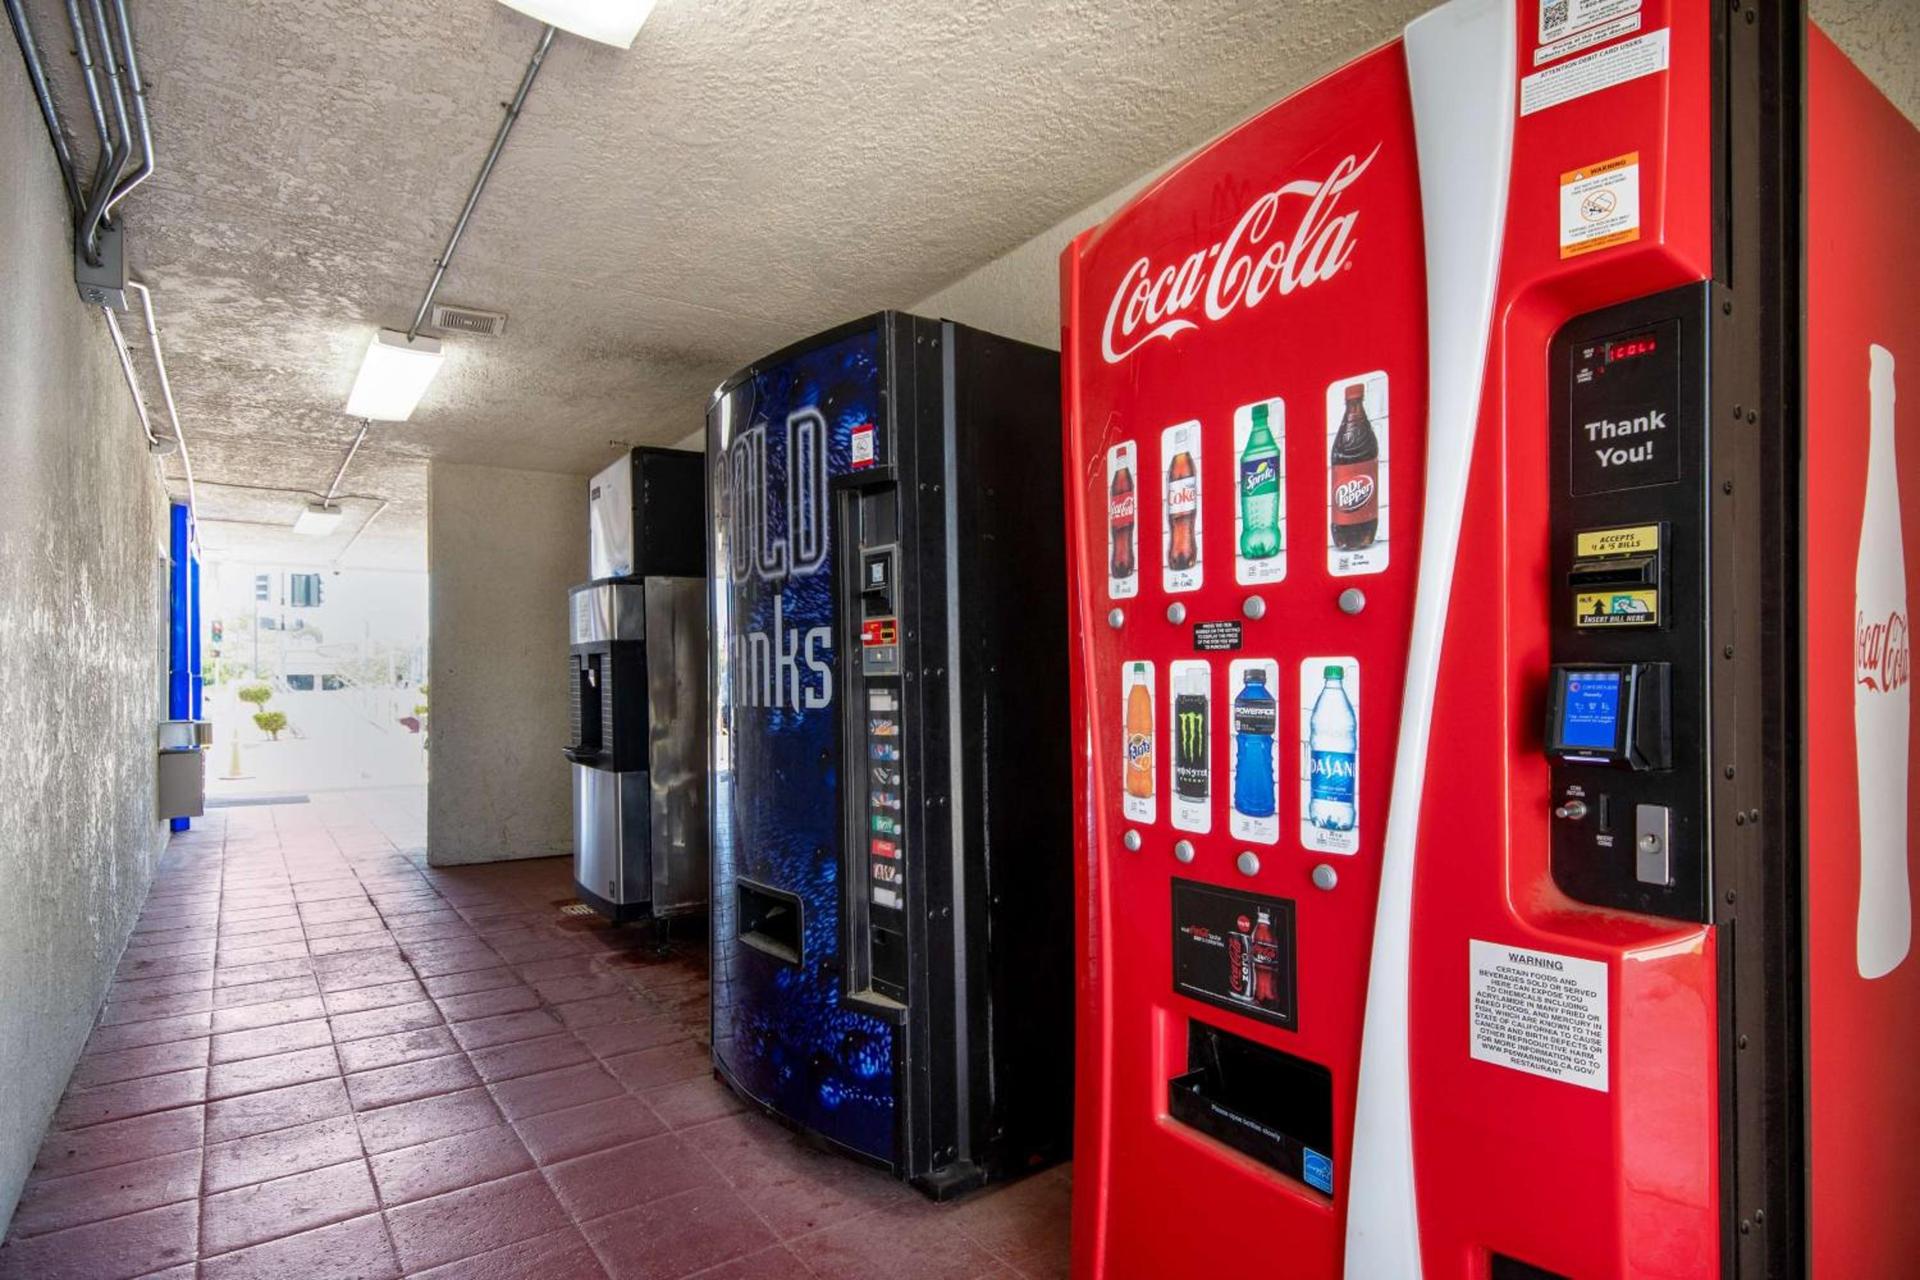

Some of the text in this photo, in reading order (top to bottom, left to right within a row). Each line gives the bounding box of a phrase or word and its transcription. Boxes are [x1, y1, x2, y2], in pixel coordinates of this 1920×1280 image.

[1540, 61, 1578, 78] ATTENTION
[1578, 53, 1599, 66] DEBIT
[1599, 46, 1619, 58] CARD
[1590, 159, 1627, 175] WARNING
[1102, 139, 1384, 364] Coca-Cola
[1584, 410, 1666, 442] Thank
[1596, 441, 1653, 468] You!
[1246, 466, 1275, 490] Sprite
[1348, 479, 1364, 492] Dr
[1336, 481, 1373, 507] Pepper
[1599, 533, 1635, 543] ACCEPTS
[1618, 540, 1641, 549] BILLS
[1584, 615, 1608, 623] INSERT
[1626, 614, 1645, 622] HERE
[1310, 755, 1355, 780] DASANI
[1508, 952, 1564, 970] WARNING
[1479, 969, 1597, 998] BEVERAGES SOLD OR SERVED
[1496, 966, 1577, 986] CERTAIN FOODS AND
[1490, 980, 1582, 1003] HERE CAN EXPOSE YOU
[1498, 988, 1542, 1002] CHEMICALS
[1544, 998, 1588, 1012] INCLUDING
[1475, 998, 1500, 1008] BAKED
[1532, 1010, 1550, 1019] AND
[1551, 1014, 1591, 1026] MERCURY
[1593, 1022, 1602, 1030] IN
[1477, 990, 1525, 1006] ACRYLAMIDE
[1536, 1004, 1559, 1013] MANY
[1561, 1008, 1586, 1019] FRIED
[1587, 1014, 1600, 1022] OR
[1475, 1012, 1497, 1022] STATE
[1512, 1020, 1558, 1036] CALIFORNIA
[1573, 1034, 1602, 1046] CAUSE
[1475, 1019, 1602, 1054] CANCER AND BIRTH DEFECTS OR
[1495, 1010, 1520, 1019] WHICH
[1522, 1016, 1537, 1024] ARE
[1540, 1020, 1570, 1031] KNOWN
[1572, 1026, 1583, 1034] TO
[1586, 1029, 1602, 1038] THE
[1477, 1034, 1600, 1069] FOR MORE INFORMATION GO TO
[1480, 1028, 1505, 1038] OTHER
[1507, 1034, 1567, 1054] REPRODUCTIVE
[1510, 1057, 1562, 1075] RESTAURANT
